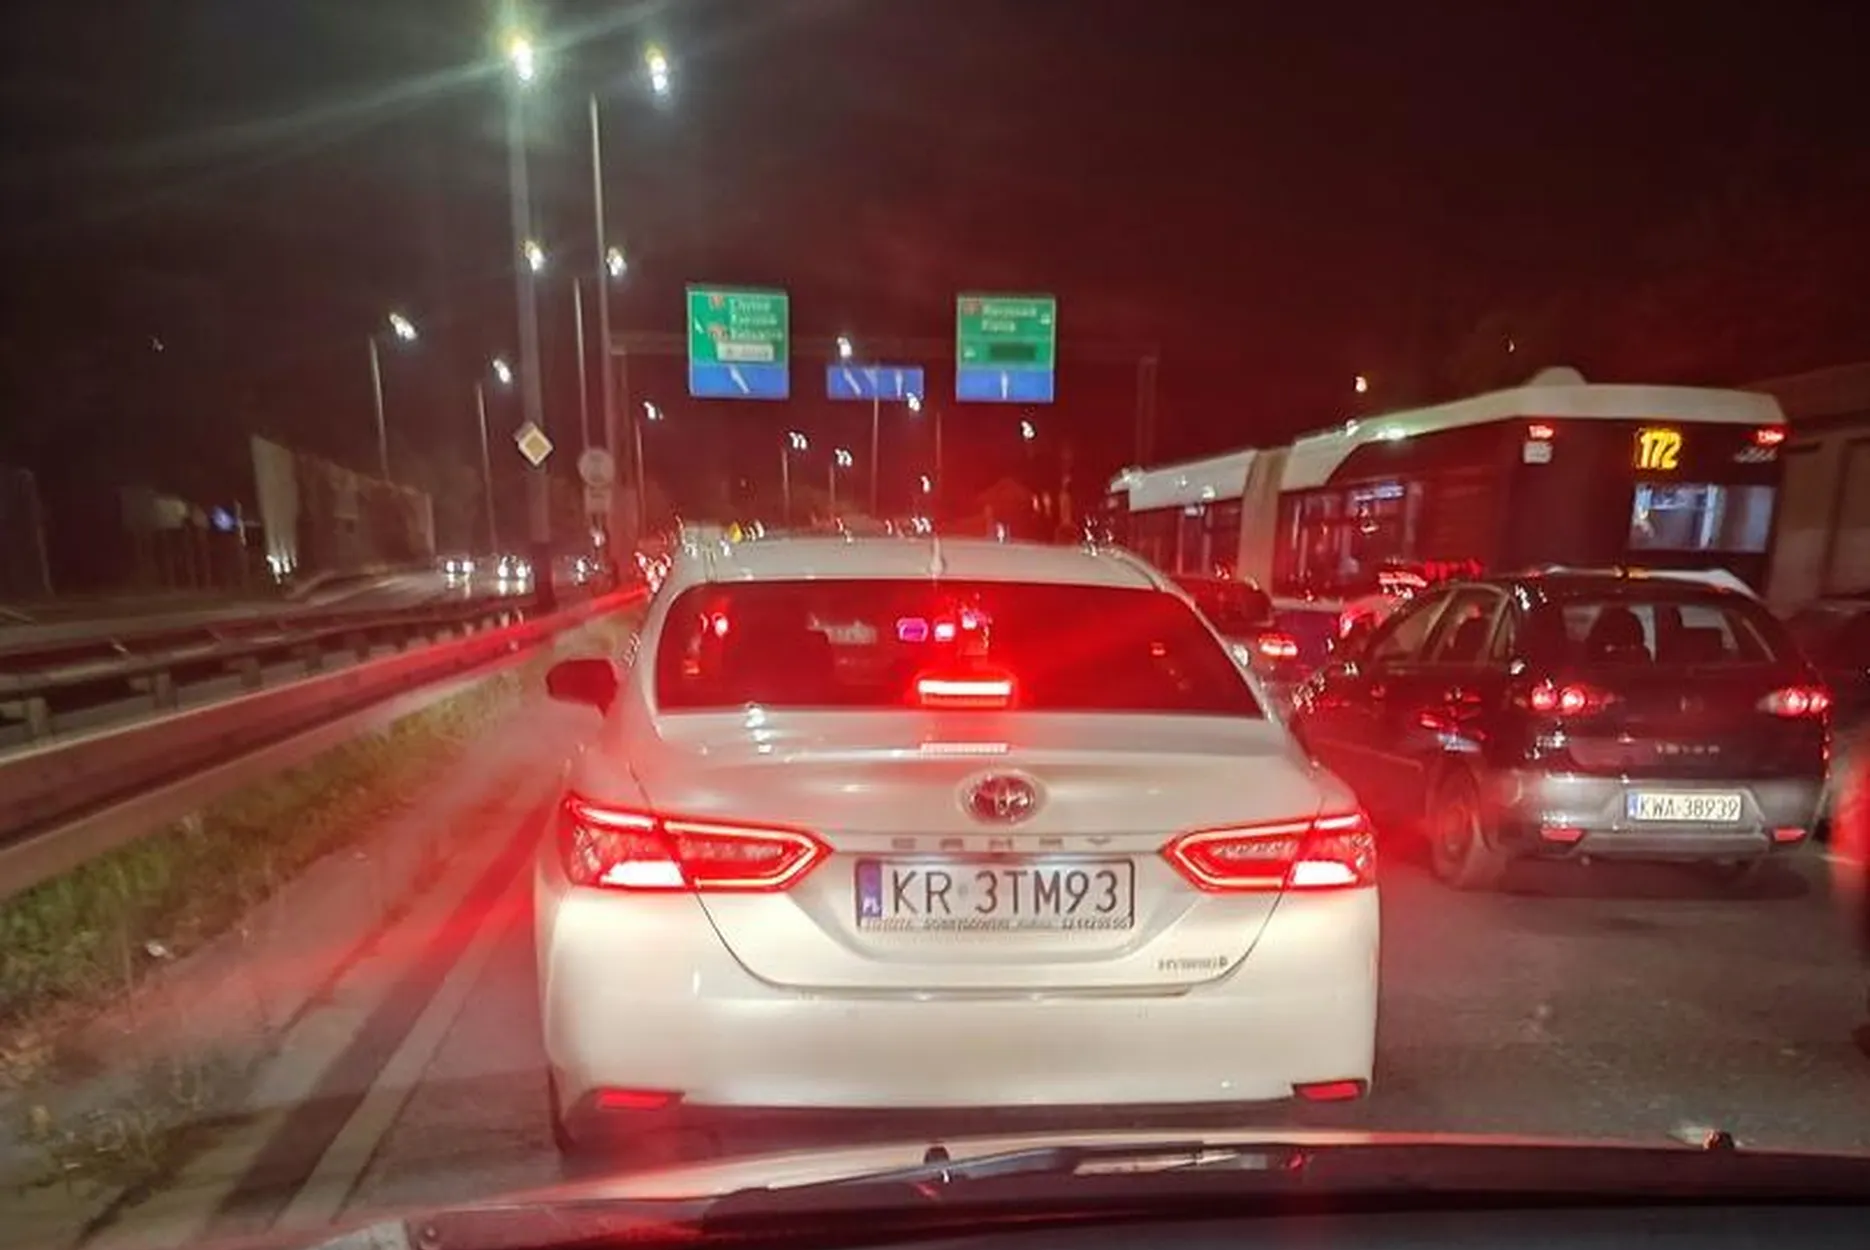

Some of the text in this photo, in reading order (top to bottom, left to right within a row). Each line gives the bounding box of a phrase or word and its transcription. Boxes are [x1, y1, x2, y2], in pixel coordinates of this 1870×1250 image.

[1637, 428, 1683, 470] 172
[1640, 796, 1740, 819] KWA 38939
[891, 869, 1119, 915] KR 3TM93
